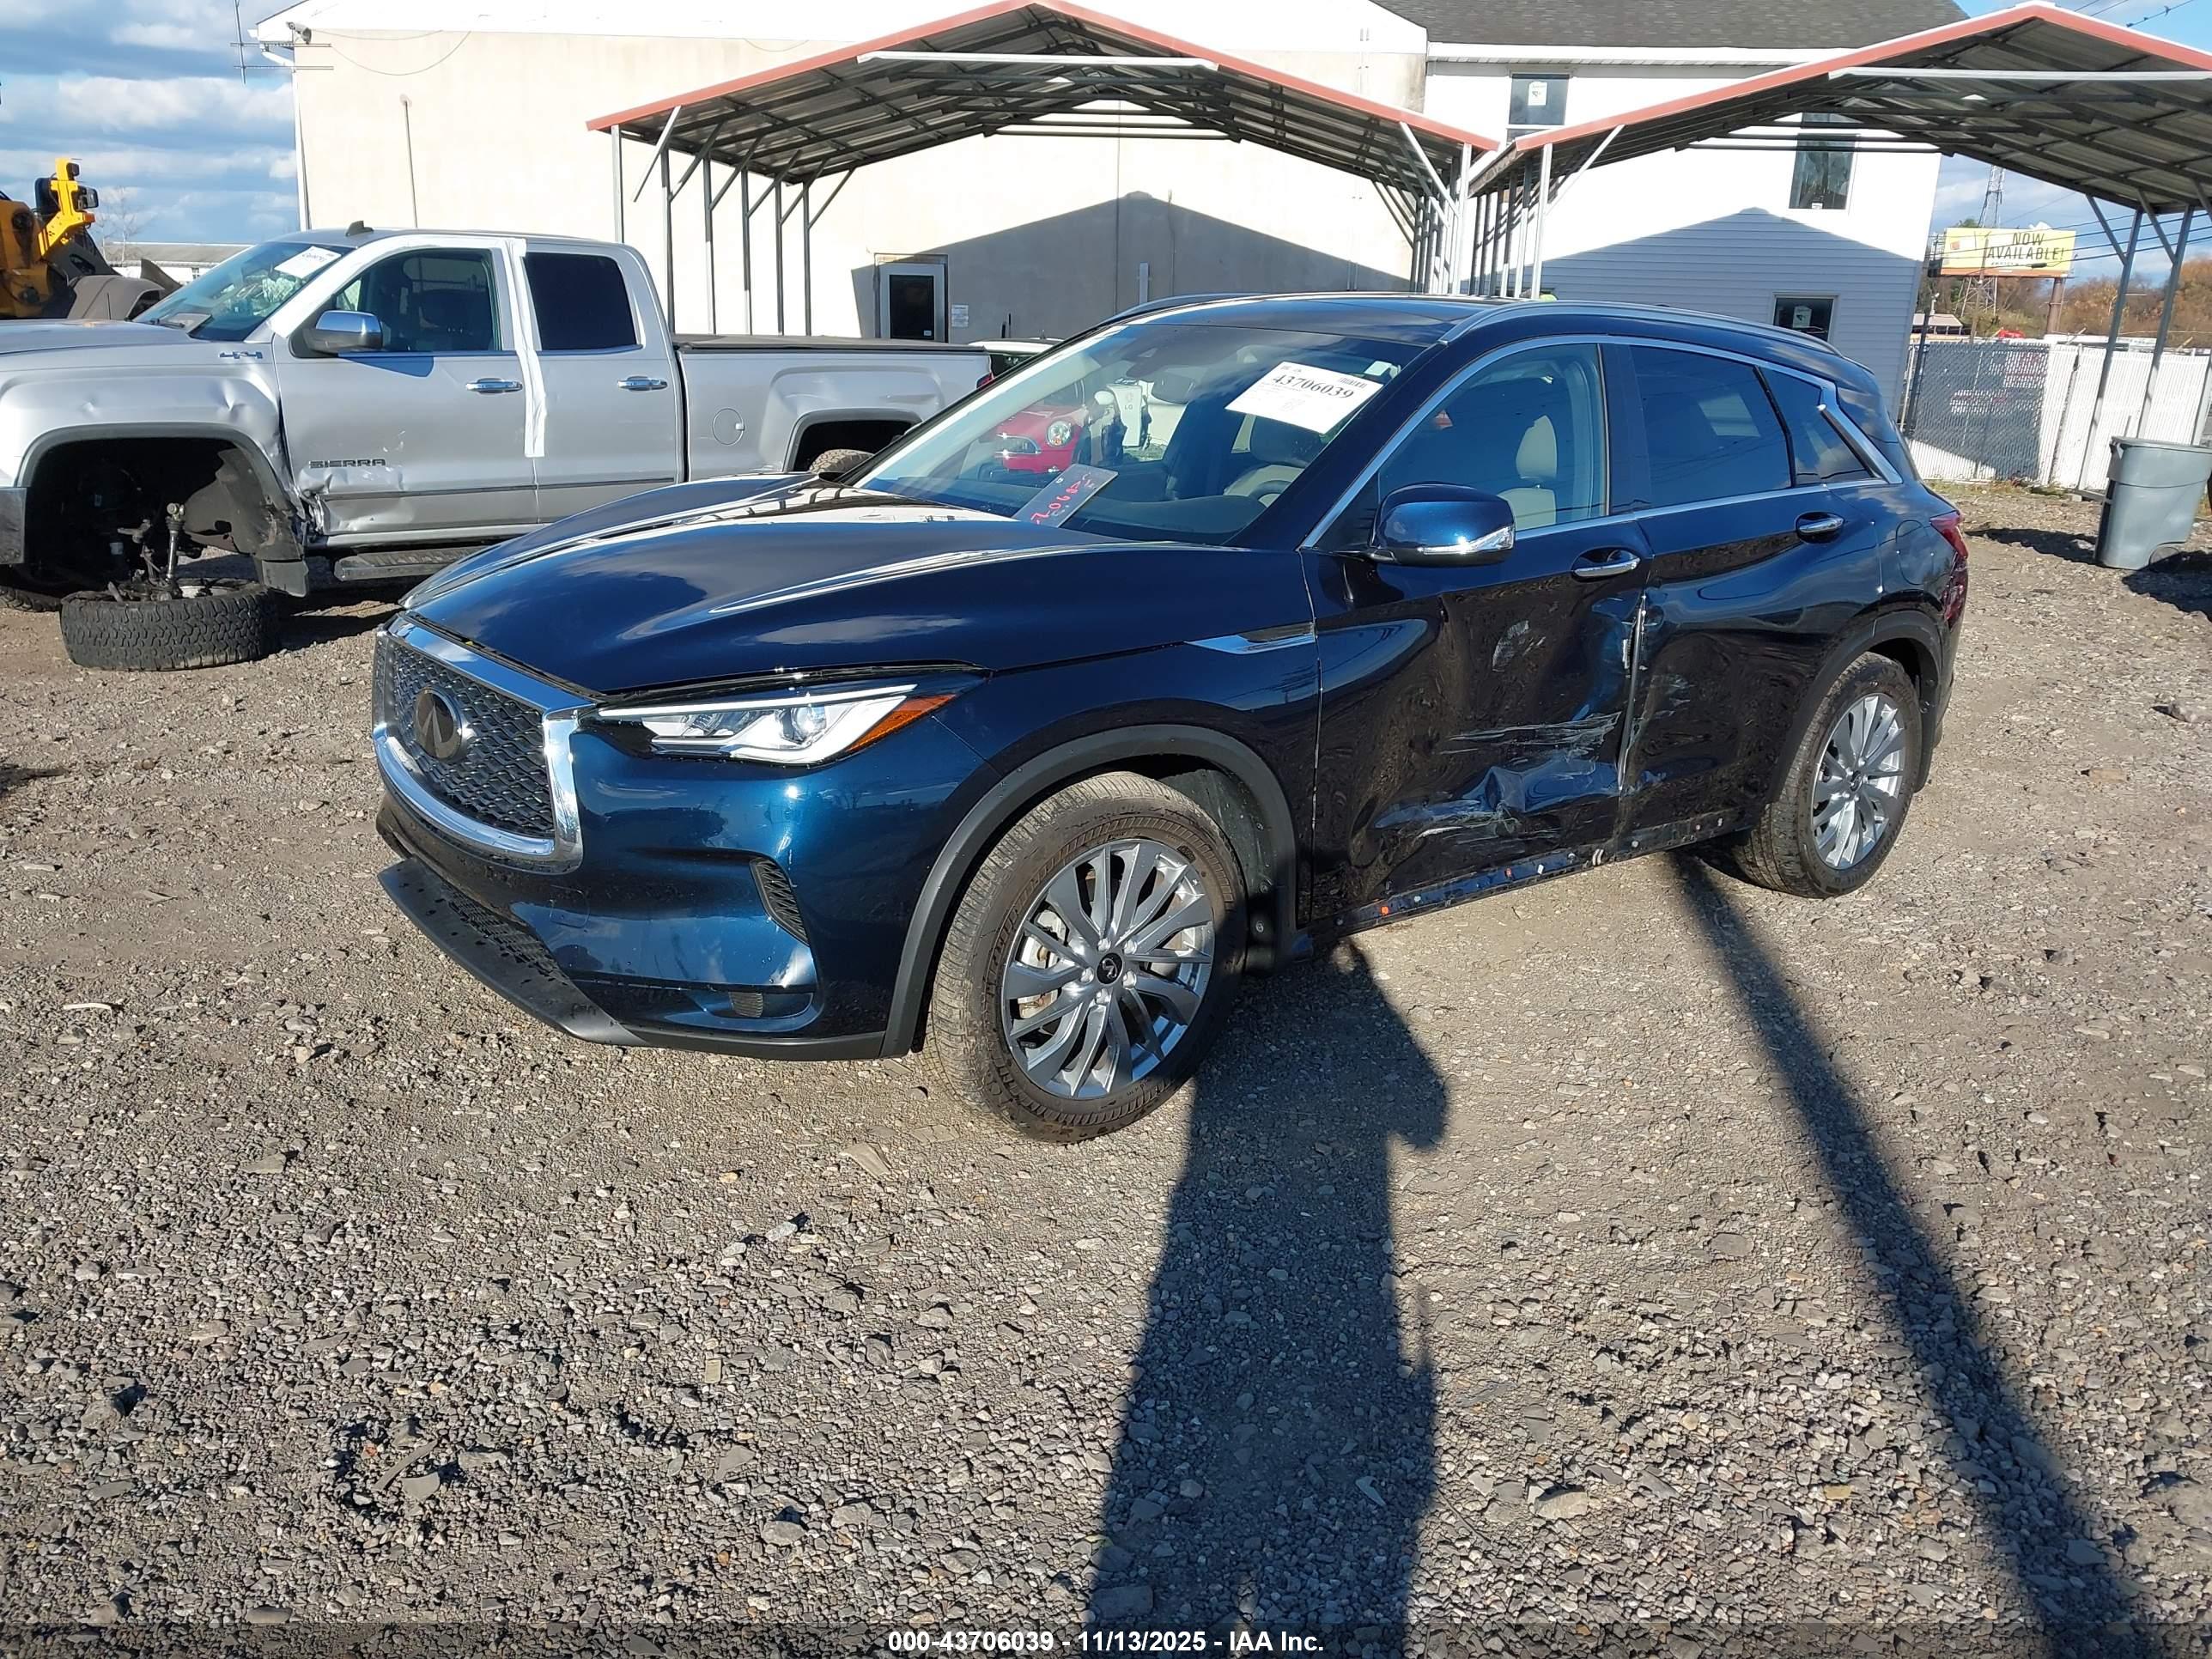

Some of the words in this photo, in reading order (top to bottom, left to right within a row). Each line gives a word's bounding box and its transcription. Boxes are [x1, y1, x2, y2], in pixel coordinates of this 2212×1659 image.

[2012, 232, 2045, 246] NOW
[1987, 246, 2064, 260] AVAILABLE!
[1273, 374, 1355, 398] 43706039
[309, 459, 386, 469] SIERRA
